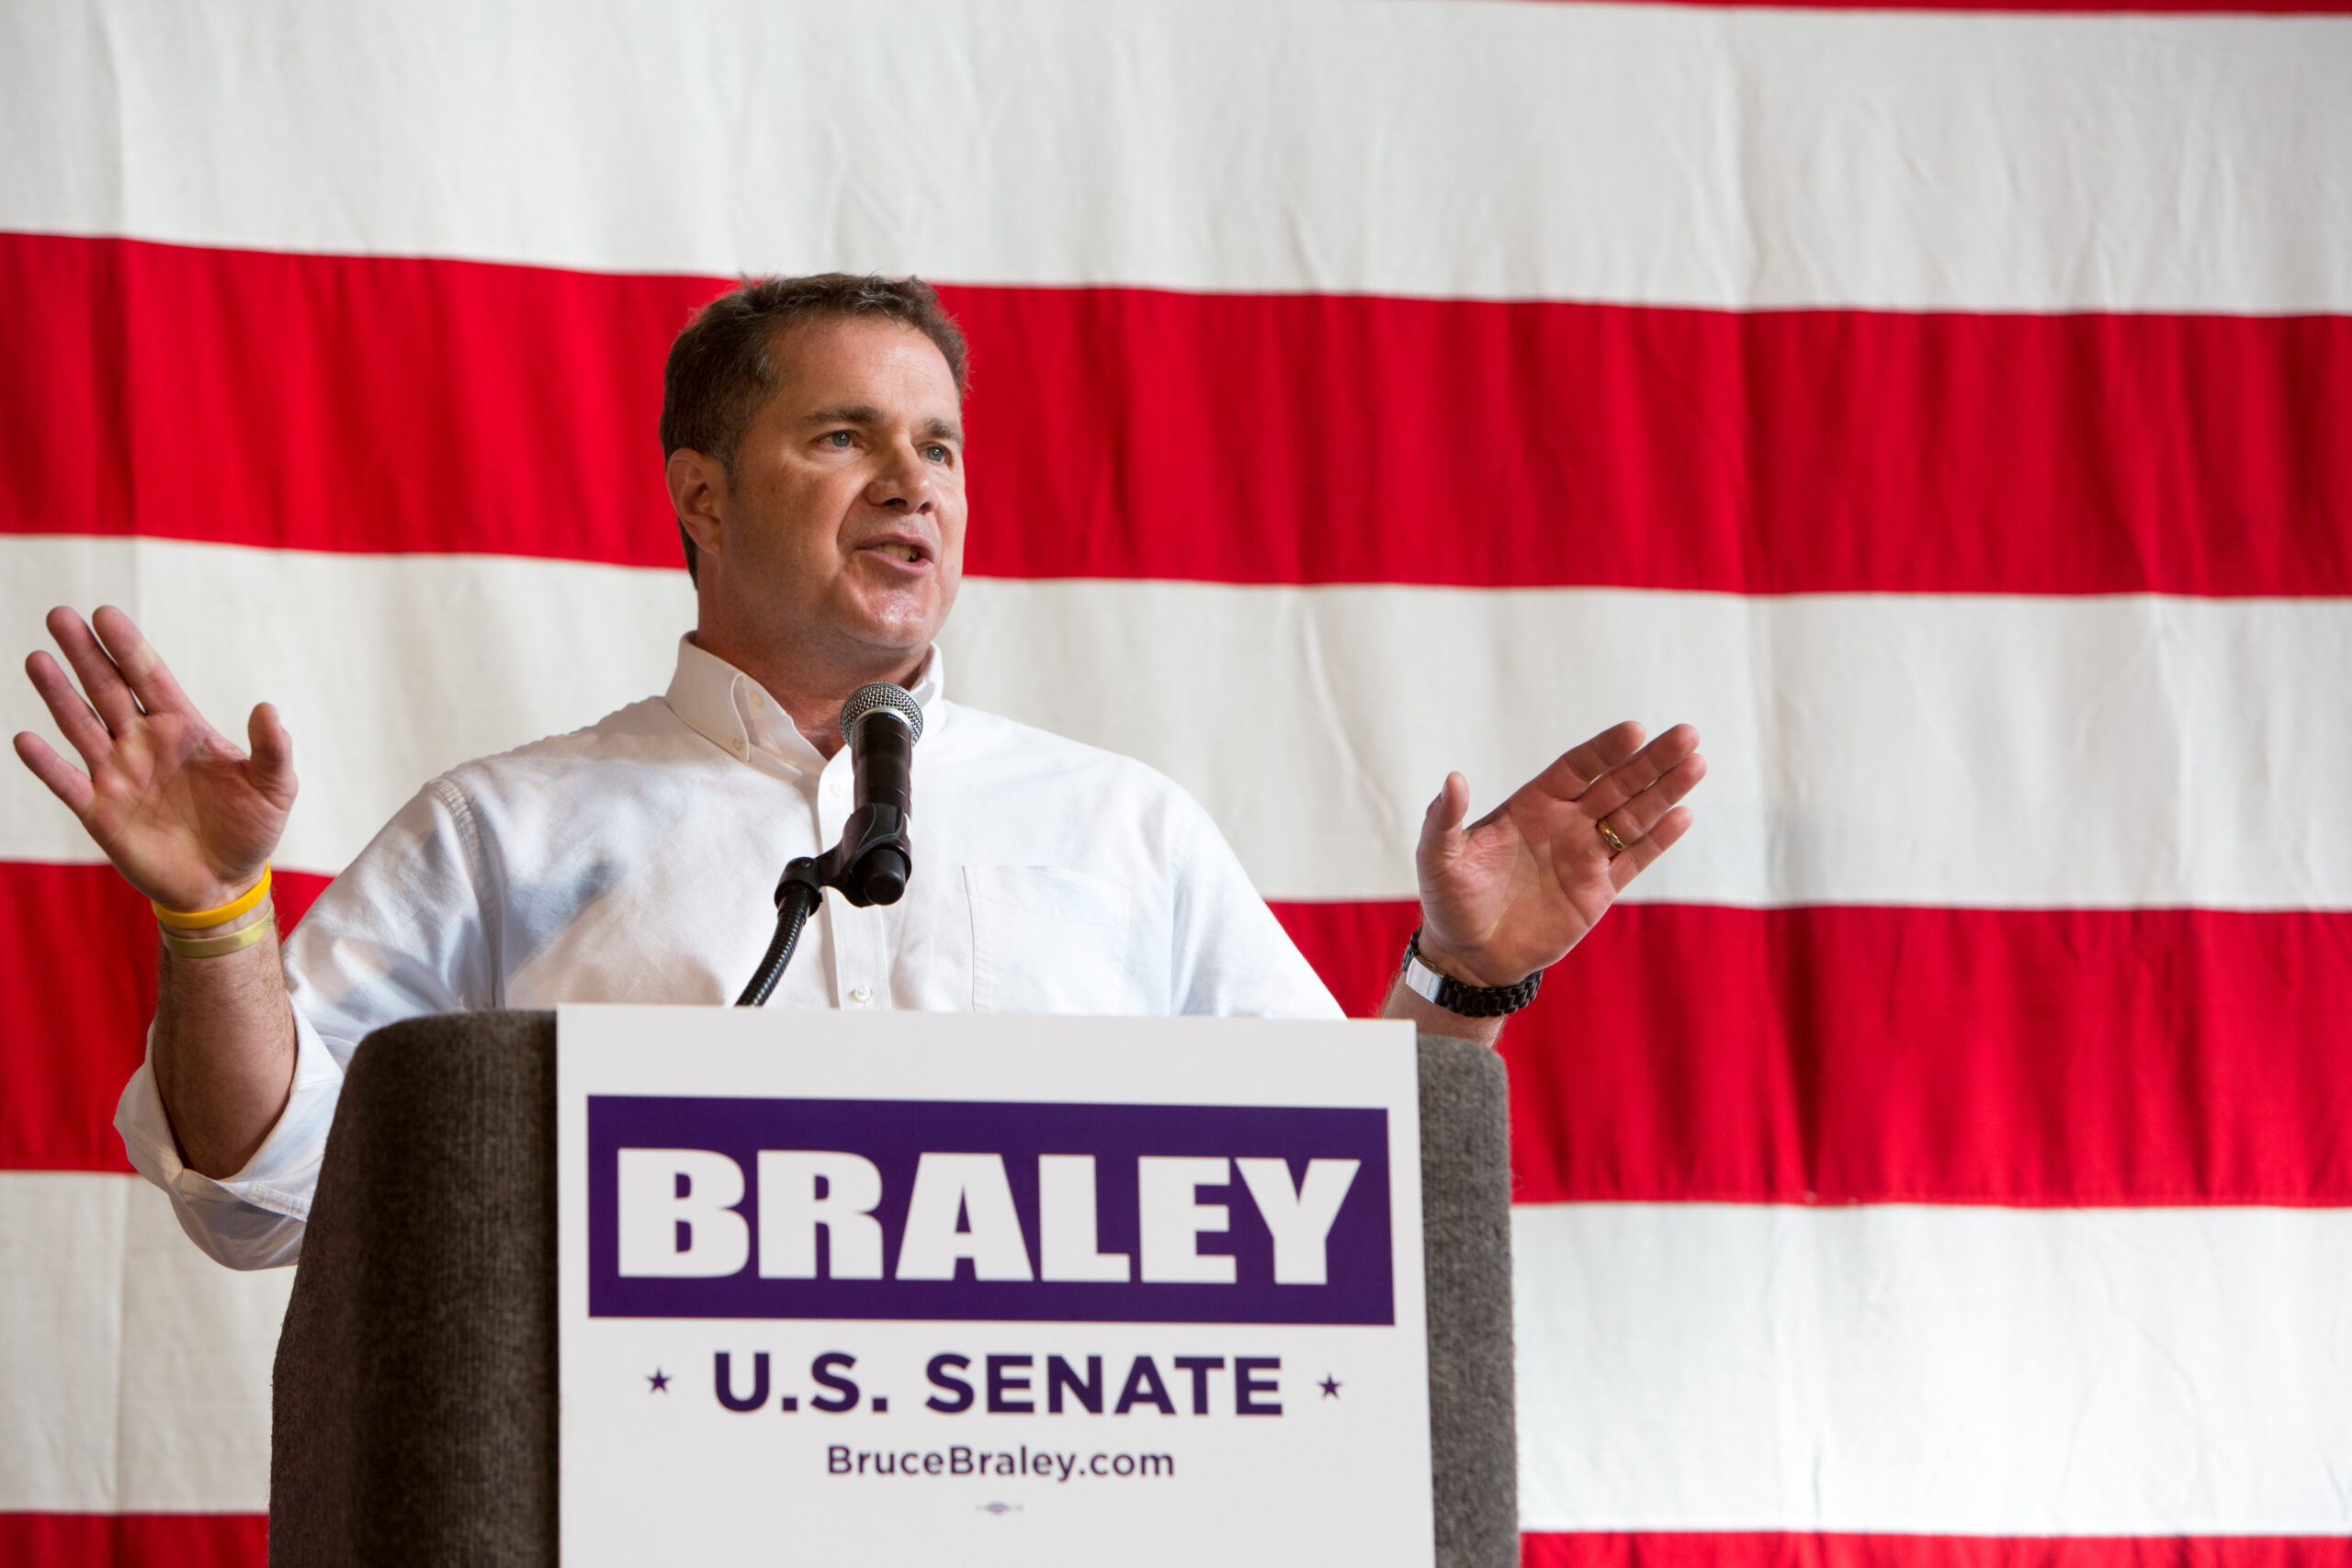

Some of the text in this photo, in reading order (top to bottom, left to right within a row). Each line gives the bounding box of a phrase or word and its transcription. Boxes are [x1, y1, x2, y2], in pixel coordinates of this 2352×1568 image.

[617, 1148, 1361, 1285] BRALEY
[714, 1351, 1283, 1416] U.S. SENATE
[828, 1445, 1174, 1483] BruceBraley.com
